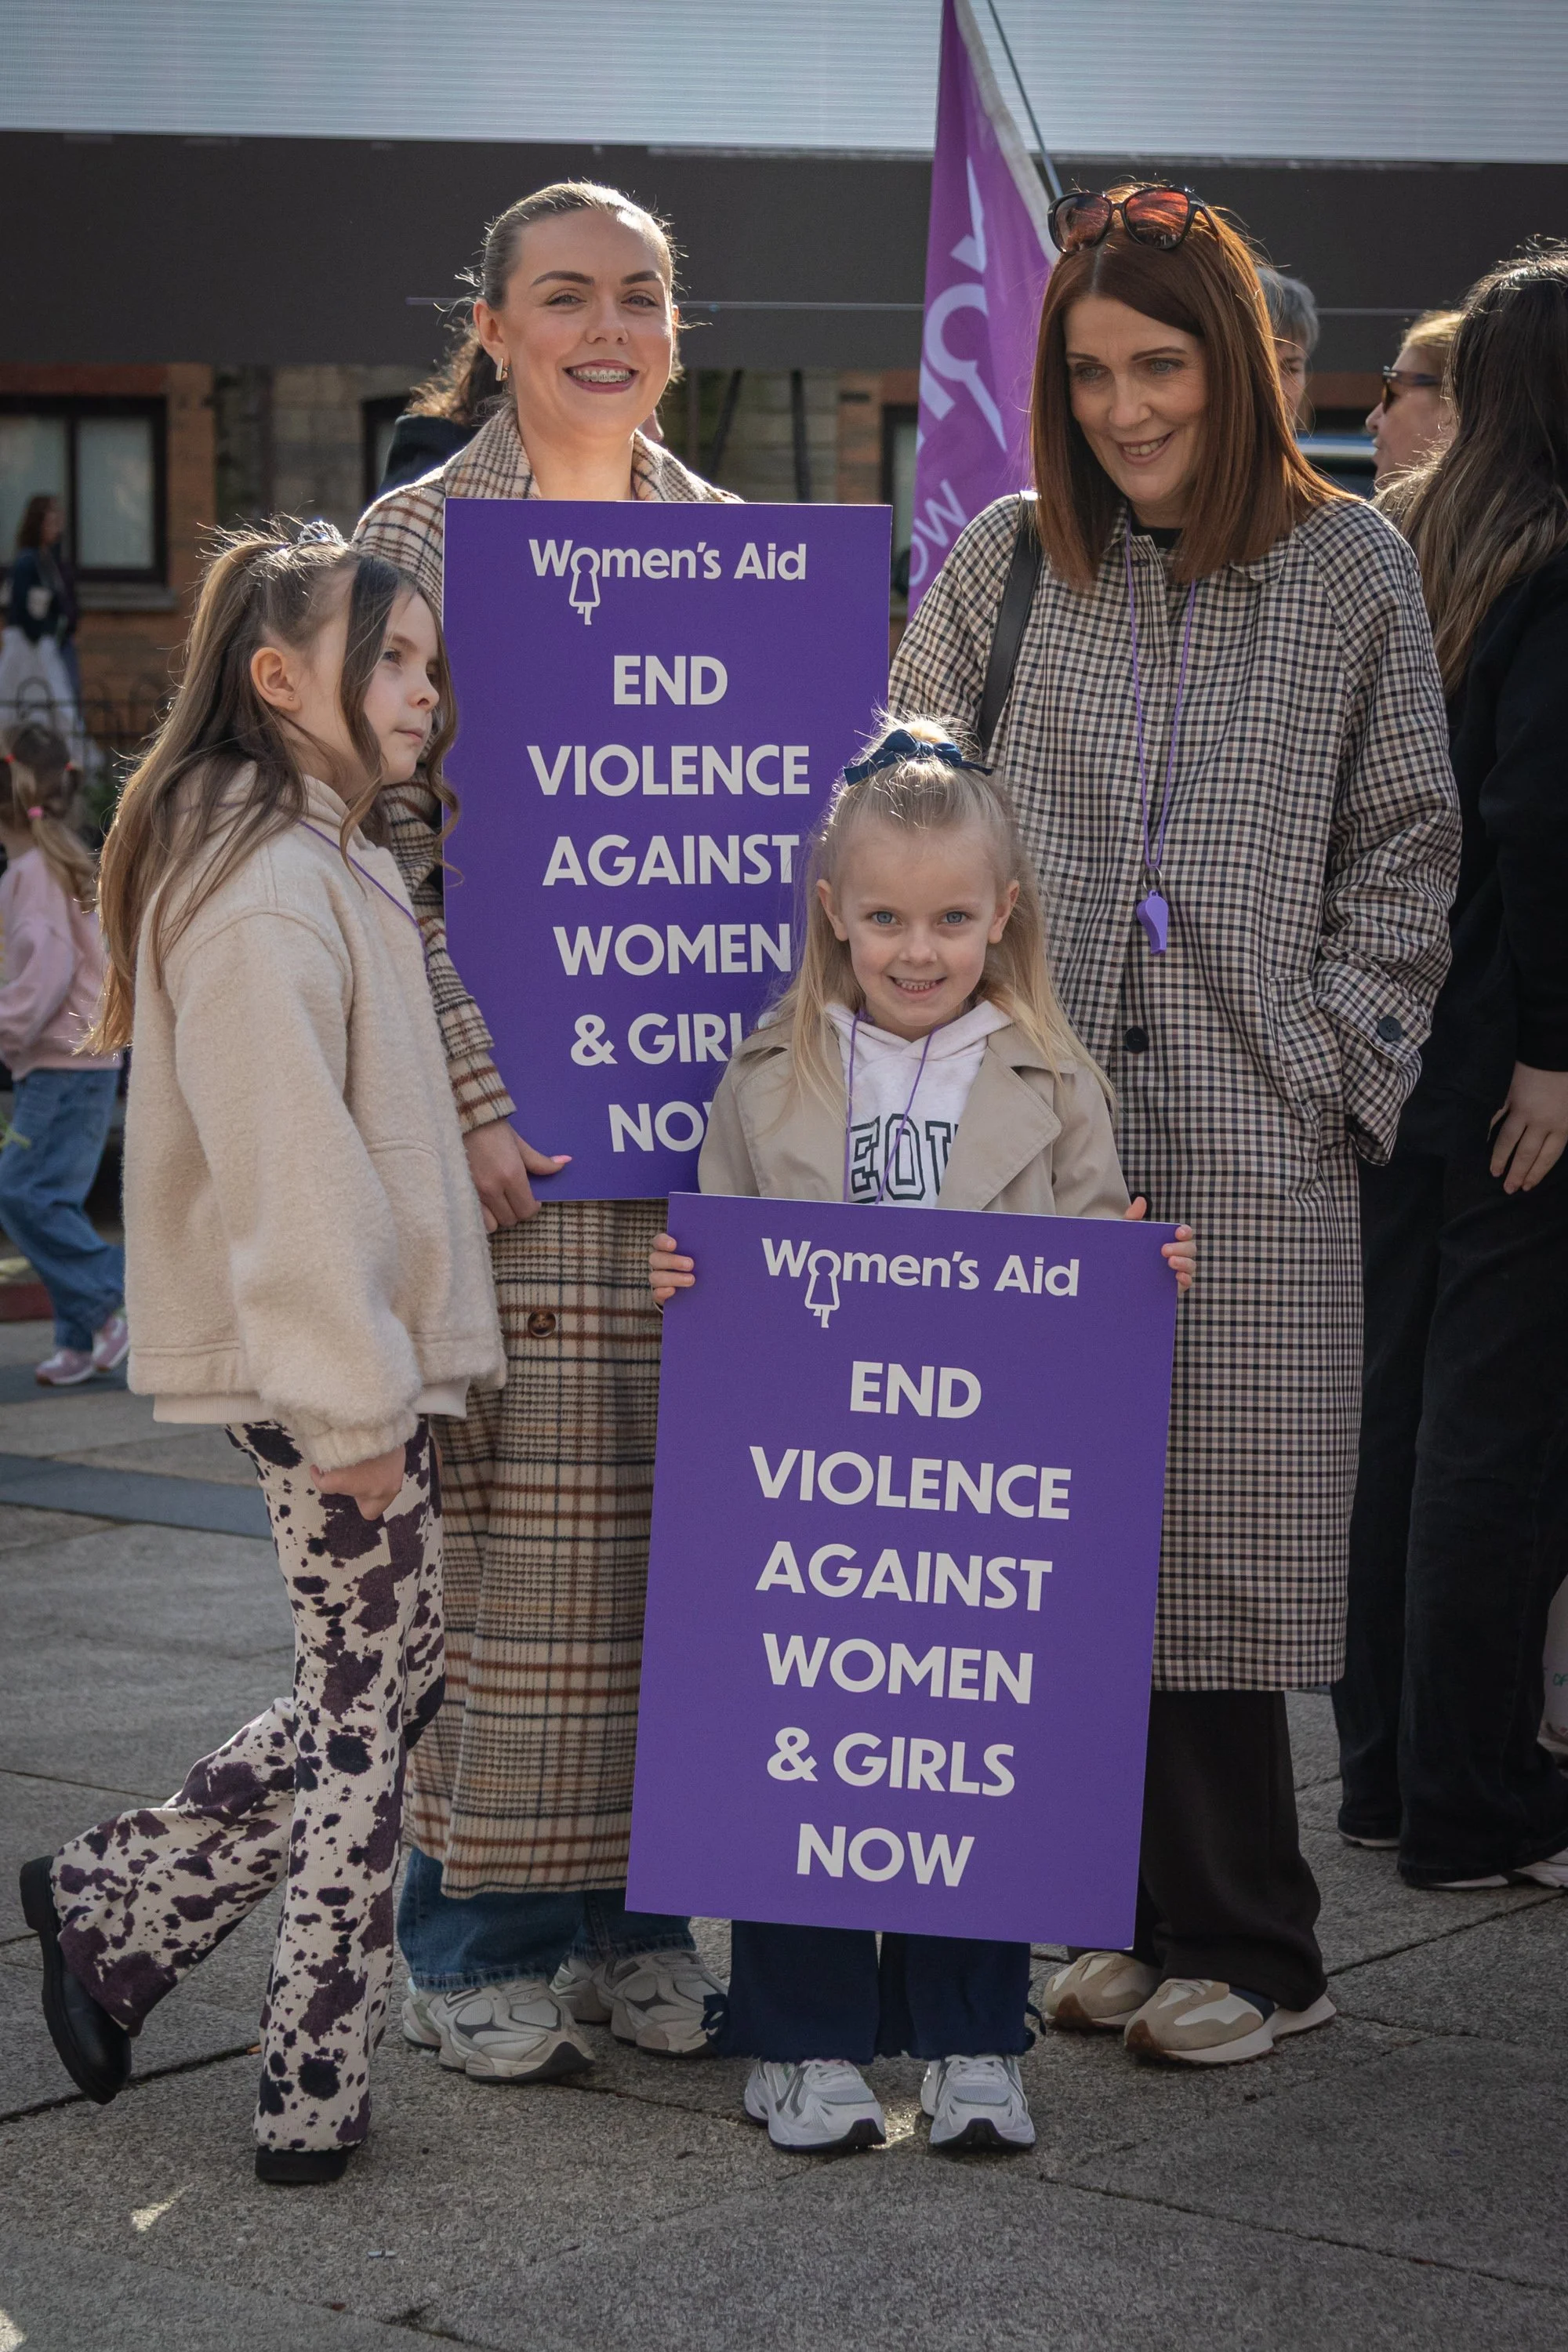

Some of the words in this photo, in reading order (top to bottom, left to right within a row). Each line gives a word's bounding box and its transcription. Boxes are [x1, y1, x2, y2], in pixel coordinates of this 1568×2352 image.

[528, 539, 722, 608] Women's
[733, 542, 807, 581] Aid
[613, 655, 728, 706] END
[526, 743, 810, 797] VIOLENCE
[542, 833, 800, 887] AGAINST
[552, 923, 792, 976] WOMEN
[570, 1014, 619, 1066] &
[627, 1012, 779, 1063] GIRL
[608, 1101, 713, 1152] NO
[761, 1237, 980, 1311] Women's
[993, 1254, 1080, 1297] Aid
[850, 1360, 982, 1419] END
[749, 1446, 1072, 1520] VIOLENCE
[755, 1541, 1053, 1612] AGAINST
[762, 1632, 1033, 1704] WOMEN
[767, 1726, 818, 1782] &
[833, 1732, 1015, 1797] GIRLS
[797, 1823, 975, 1887] NOW
